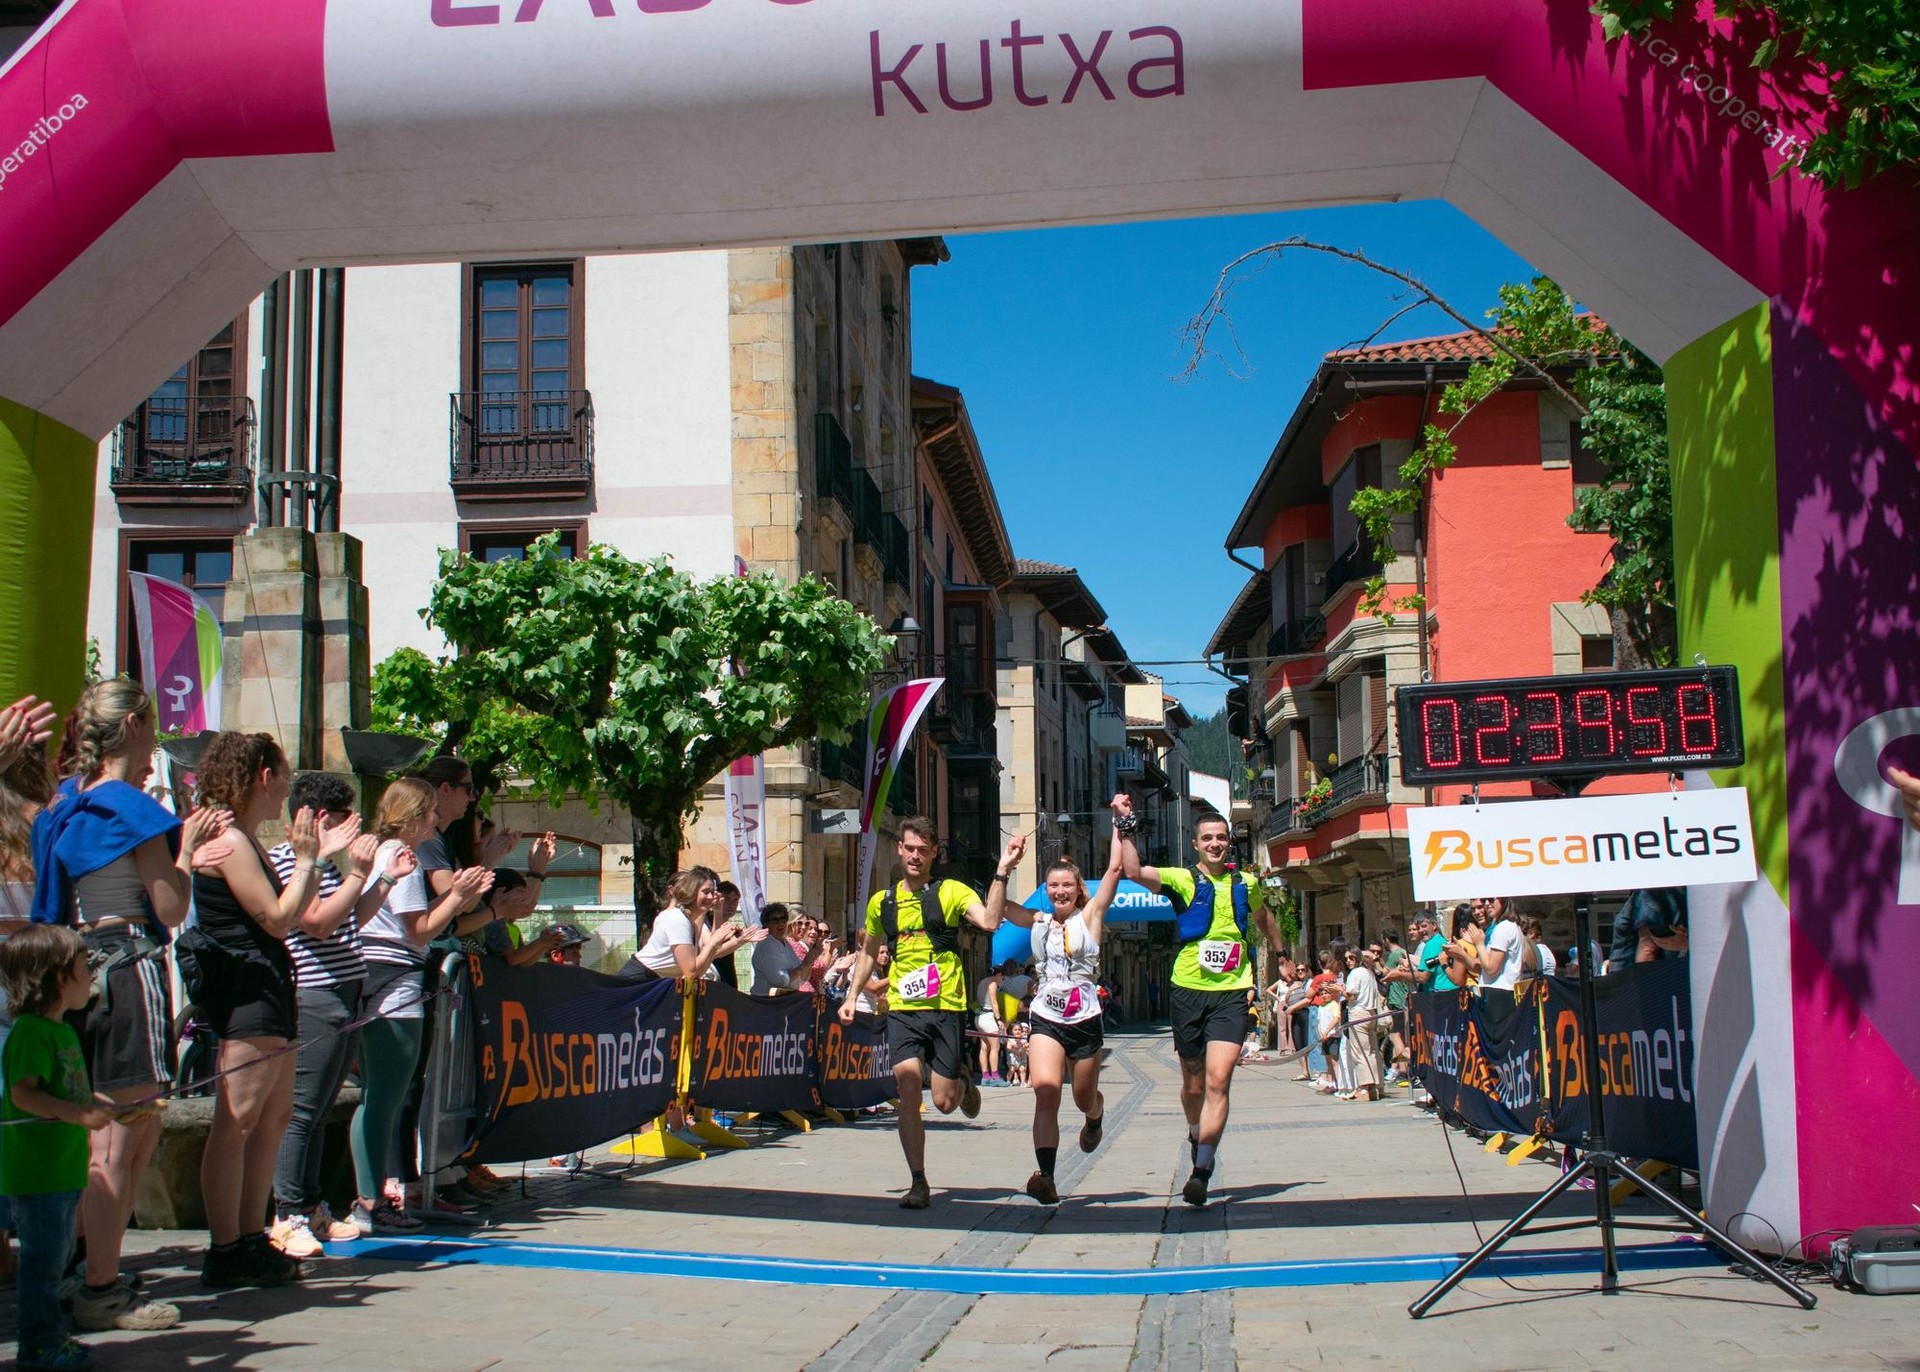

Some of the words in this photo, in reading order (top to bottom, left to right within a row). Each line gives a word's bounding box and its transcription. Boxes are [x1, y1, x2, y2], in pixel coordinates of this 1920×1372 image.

[869, 19, 1186, 117] kutxa
[1680, 63, 1818, 178] cooperati
[1421, 684, 1719, 768] 02:39:58
[1423, 816, 1741, 879] Buscametas
[1109, 892, 1173, 908] CATHLO
[904, 978, 926, 996] 354
[1204, 949, 1227, 963] 353
[1046, 994, 1066, 1010] 356
[493, 1000, 666, 1121] Buscametas
[702, 1007, 806, 1093] Buscametas
[823, 1022, 894, 1087] Buscameta
[1415, 1012, 1459, 1077] Bmetas
[1461, 1020, 1532, 1110] Bumetas
